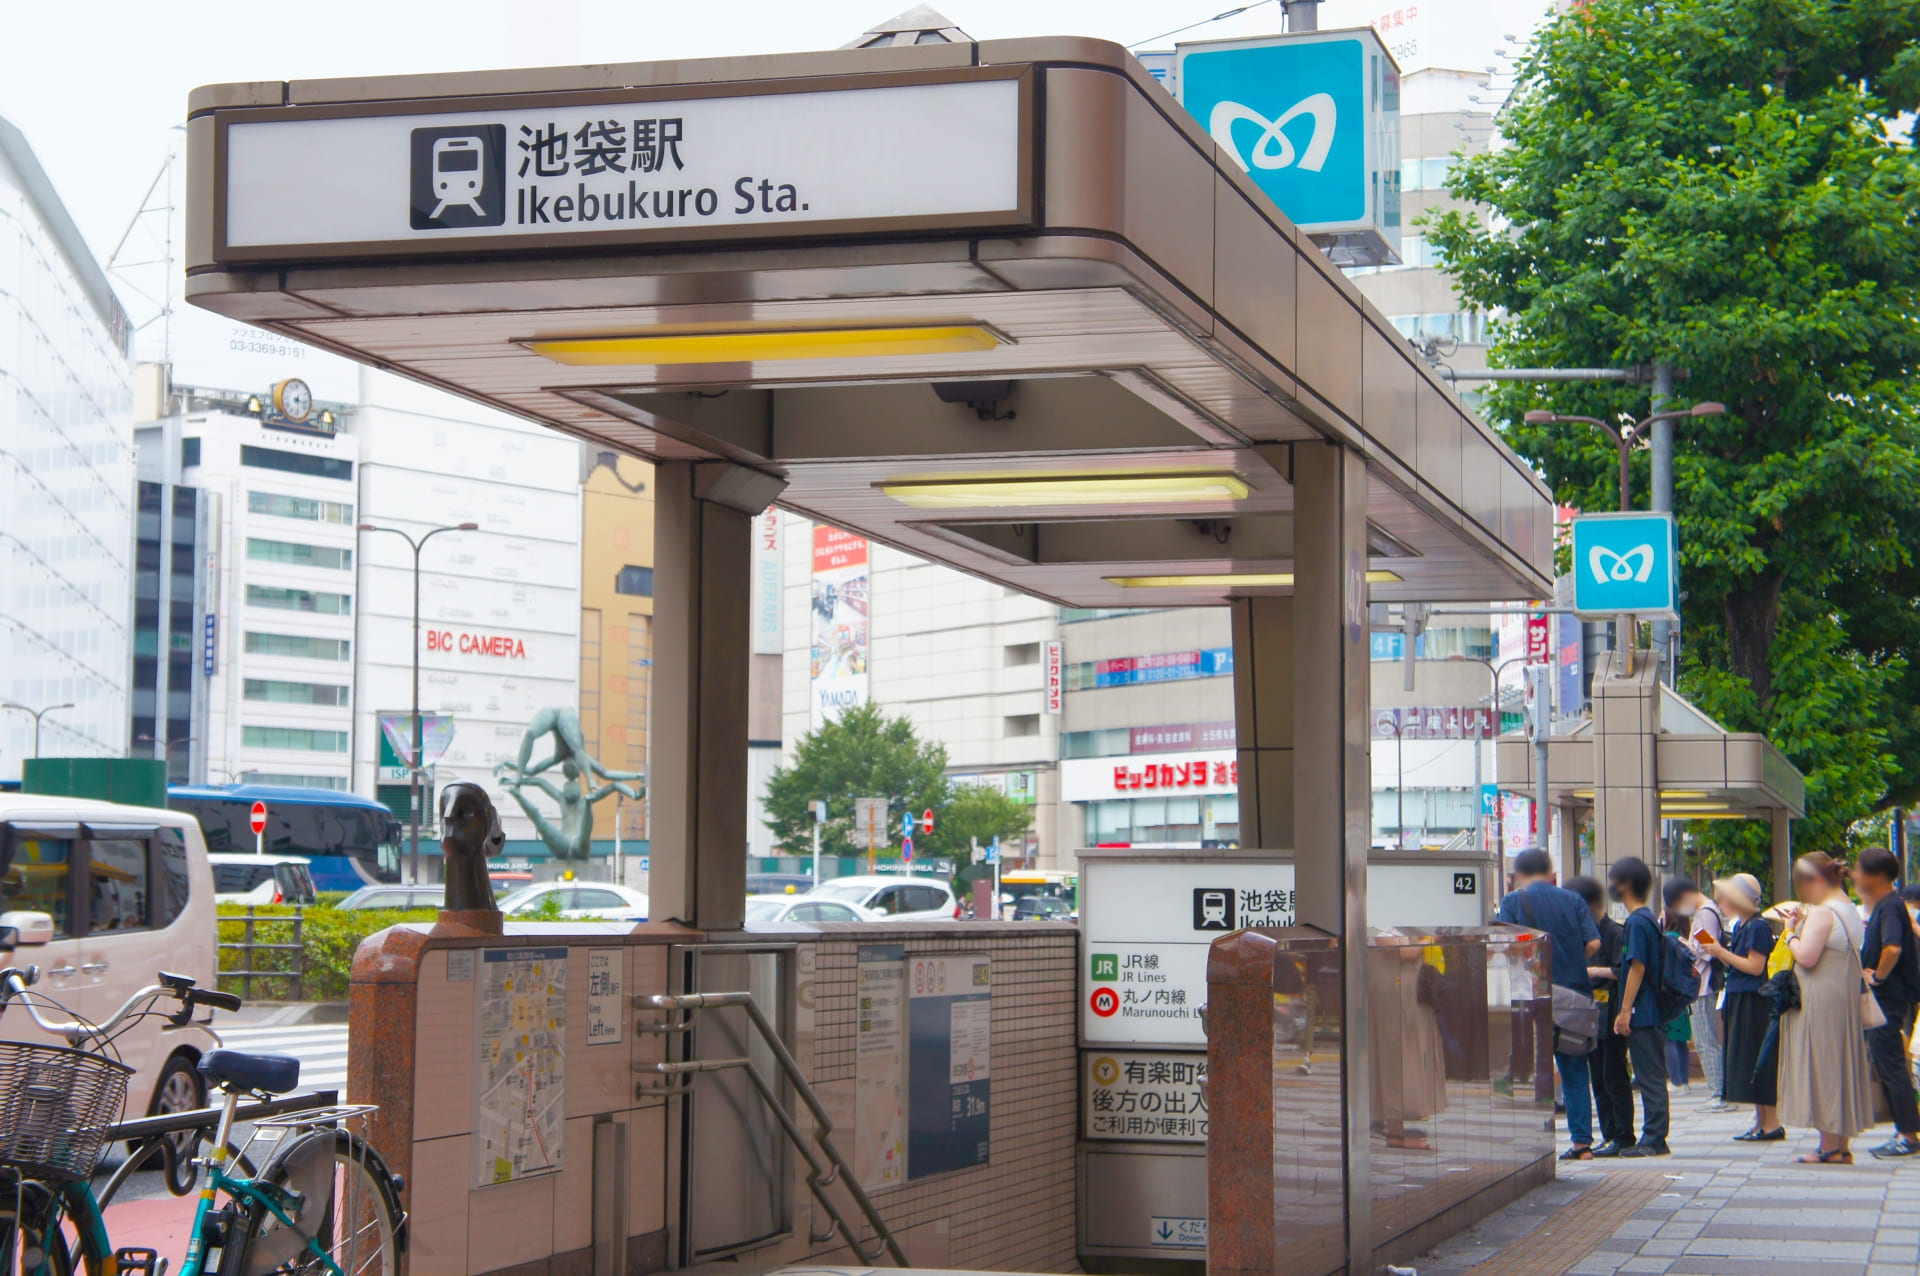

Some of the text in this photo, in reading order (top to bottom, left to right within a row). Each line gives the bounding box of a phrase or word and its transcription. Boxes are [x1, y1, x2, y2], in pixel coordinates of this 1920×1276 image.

[517, 117, 685, 179] 池袋駅
[517, 176, 810, 225] Ikebukuro Sta.
[759, 560, 777, 633] ADERANS
[426, 629, 527, 661] BIC CAMERA
[1373, 635, 1401, 654] 4F
[1049, 645, 1060, 711] ビックカメラ
[819, 689, 858, 709] YAMADA
[1114, 761, 1208, 791] ビックカメラ
[1455, 876, 1473, 892] 42
[1095, 960, 1115, 975] JR
[1122, 954, 1160, 969] JR線
[1122, 972, 1167, 983] JR Lines
[1123, 989, 1187, 1005] 丸ノ内線
[1122, 1006, 1190, 1019] Marunouchi
[589, 1019, 604, 1037] Left
[1178, 1233, 1205, 1242] Down
